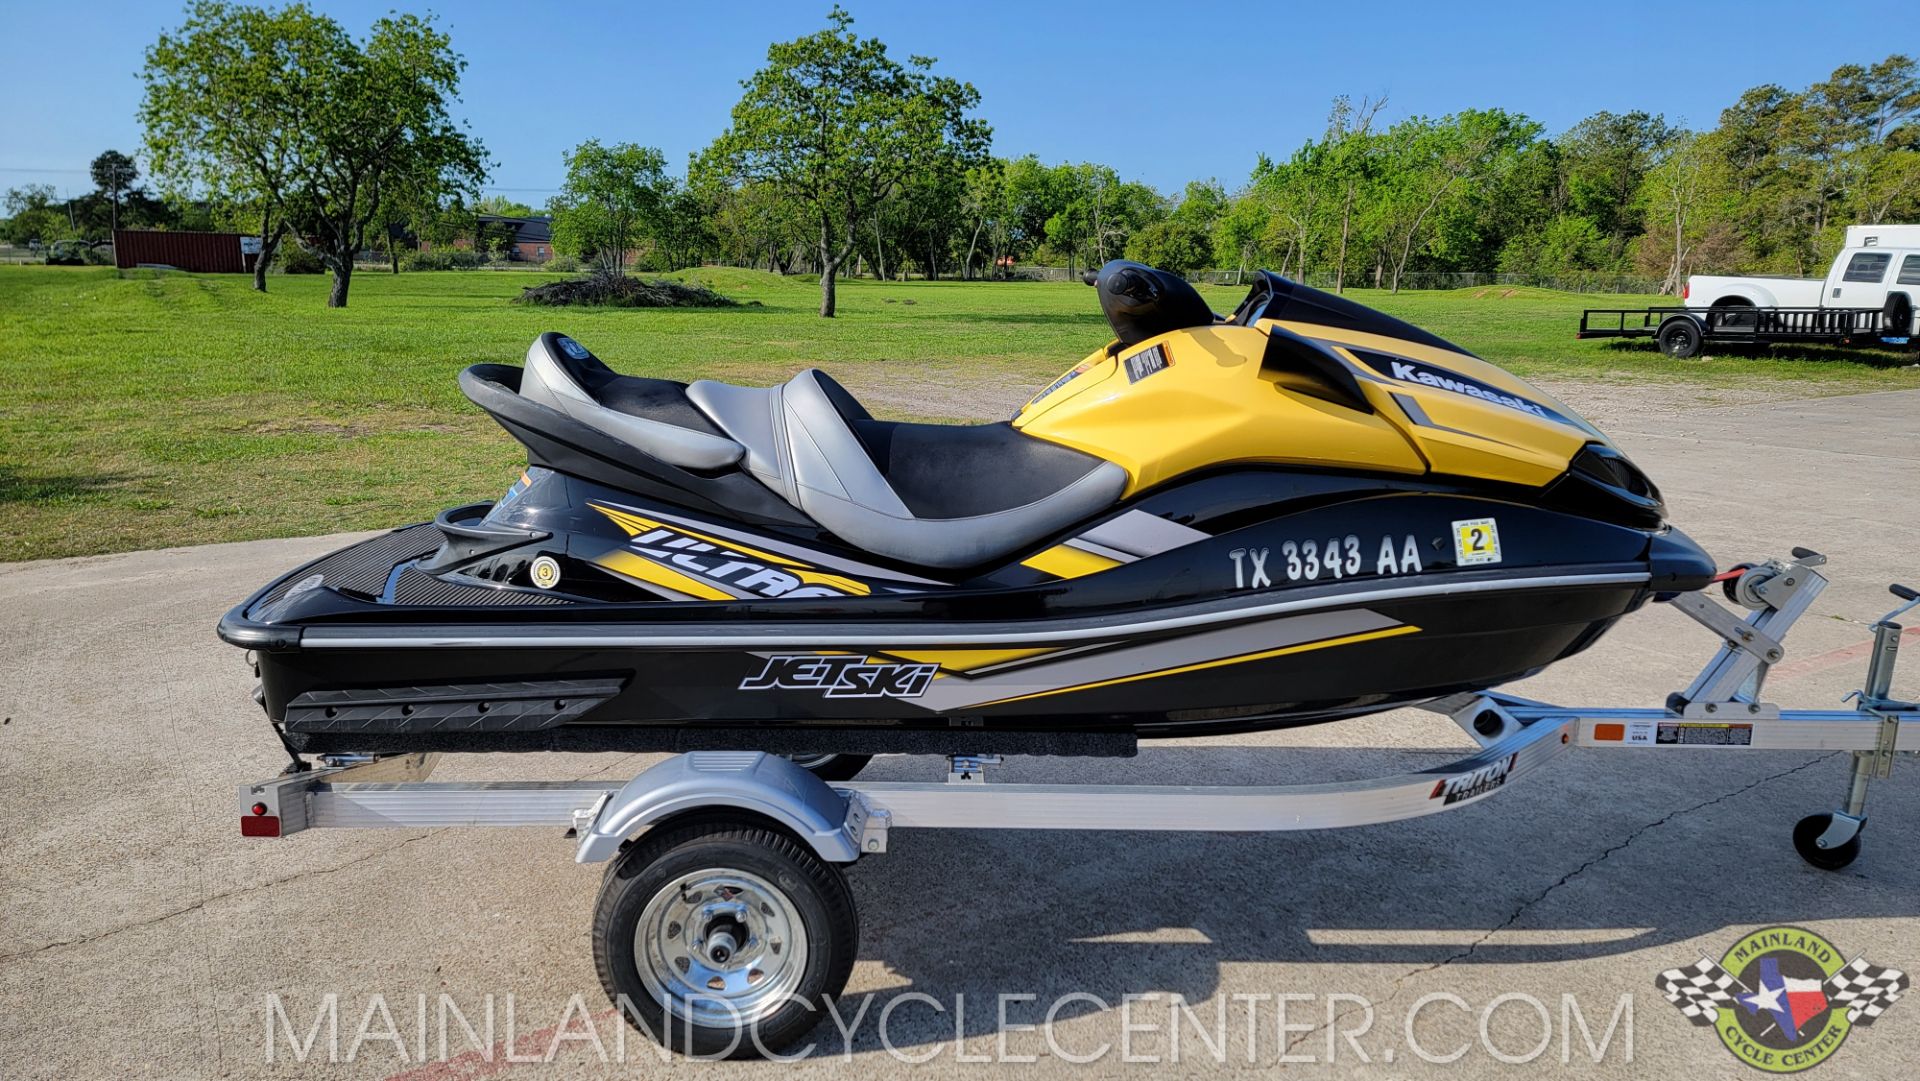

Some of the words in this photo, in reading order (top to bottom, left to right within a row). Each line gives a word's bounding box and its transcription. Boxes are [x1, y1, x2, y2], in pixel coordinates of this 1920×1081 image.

[1390, 361, 1549, 418] Kawasaki
[1470, 528, 1485, 551] 2
[1229, 547, 1271, 589] TX
[1281, 534, 1362, 581] 3343
[1376, 534, 1423, 575] AA
[1441, 755, 1515, 796] TRITON
[1455, 778, 1503, 802] TRAILERS
